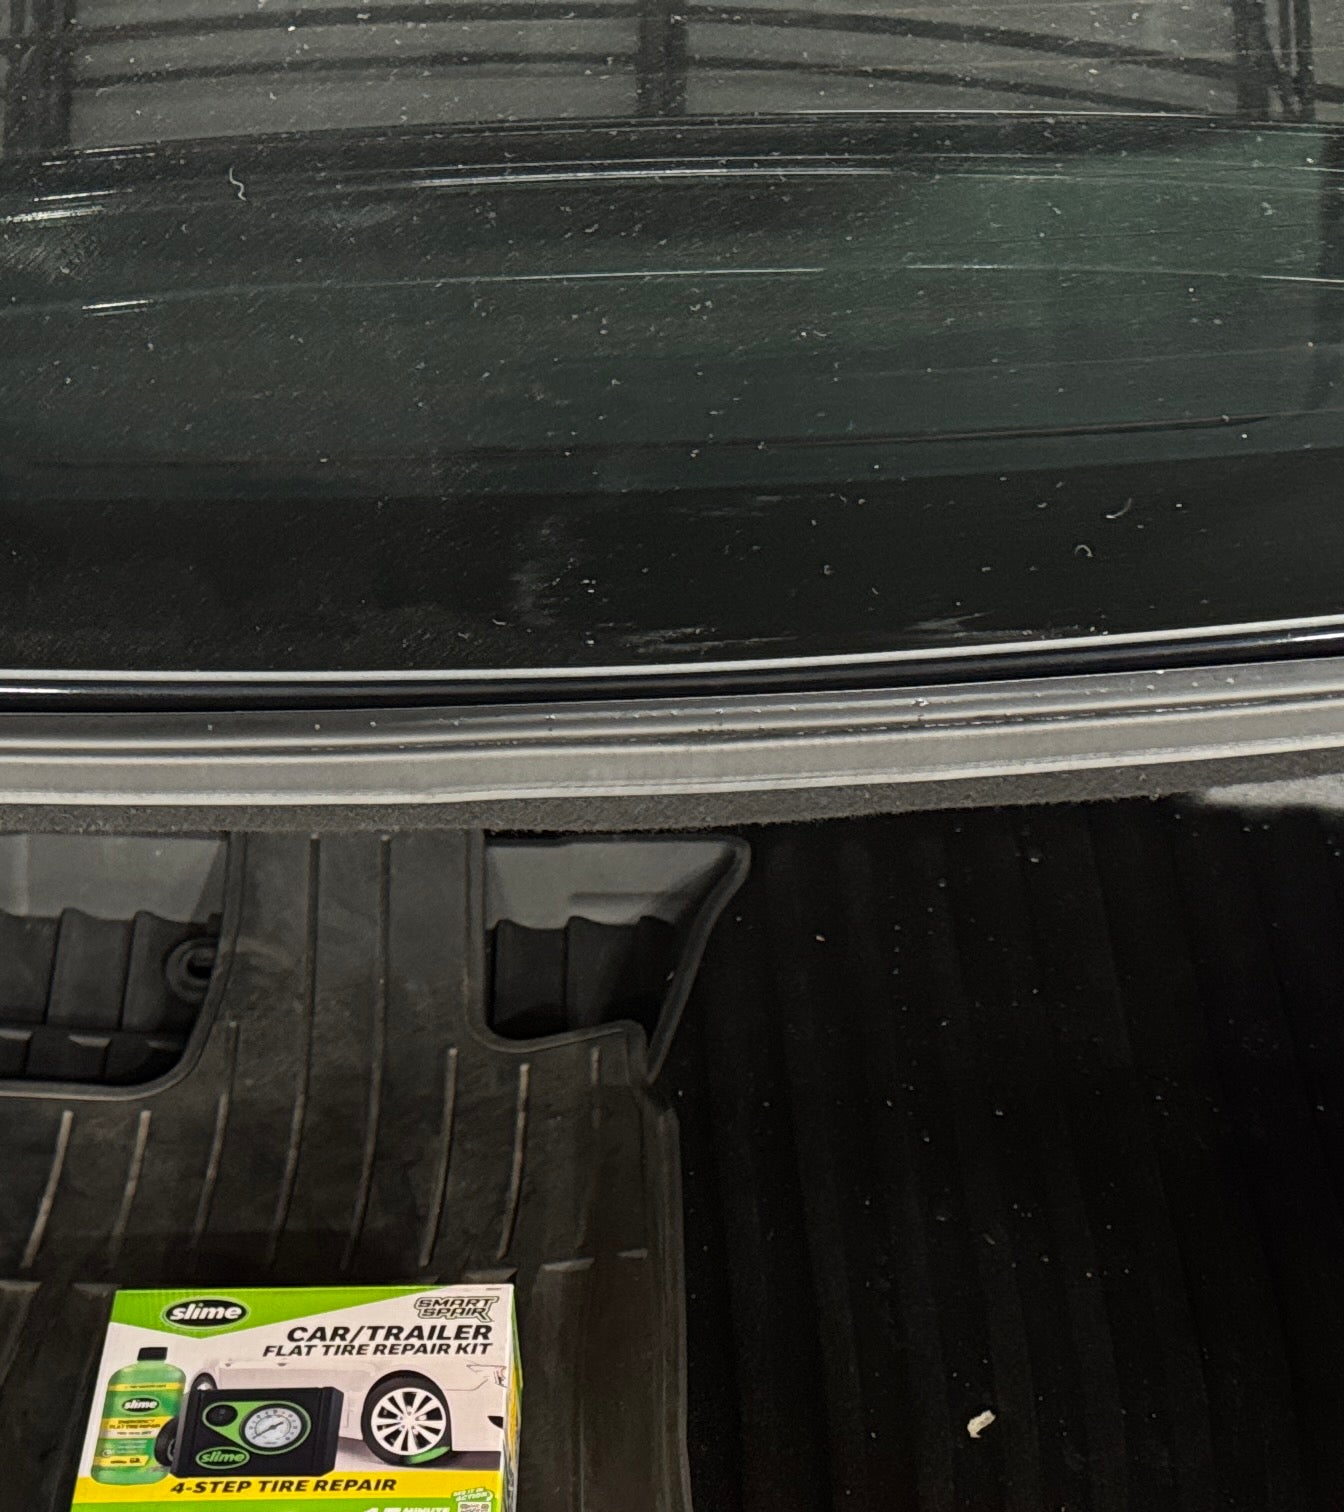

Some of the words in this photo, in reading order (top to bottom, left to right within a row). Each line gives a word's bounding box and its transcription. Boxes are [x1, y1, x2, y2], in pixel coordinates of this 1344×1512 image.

[416, 1297, 496, 1308] SMART
[169, 1303, 243, 1320] slime
[421, 1307, 489, 1321] SPAIR
[287, 1325, 493, 1342] CAR/TRAILER
[263, 1345, 317, 1357] FLAT
[320, 1344, 369, 1356] TIRE
[372, 1343, 451, 1355] REPAIR
[456, 1342, 493, 1355] KIT
[124, 1400, 158, 1409] slime
[201, 1450, 245, 1463] slime
[170, 1480, 252, 1494] 4-STEP
[258, 1480, 308, 1493] TIRE
[313, 1479, 397, 1492] REPAIR
